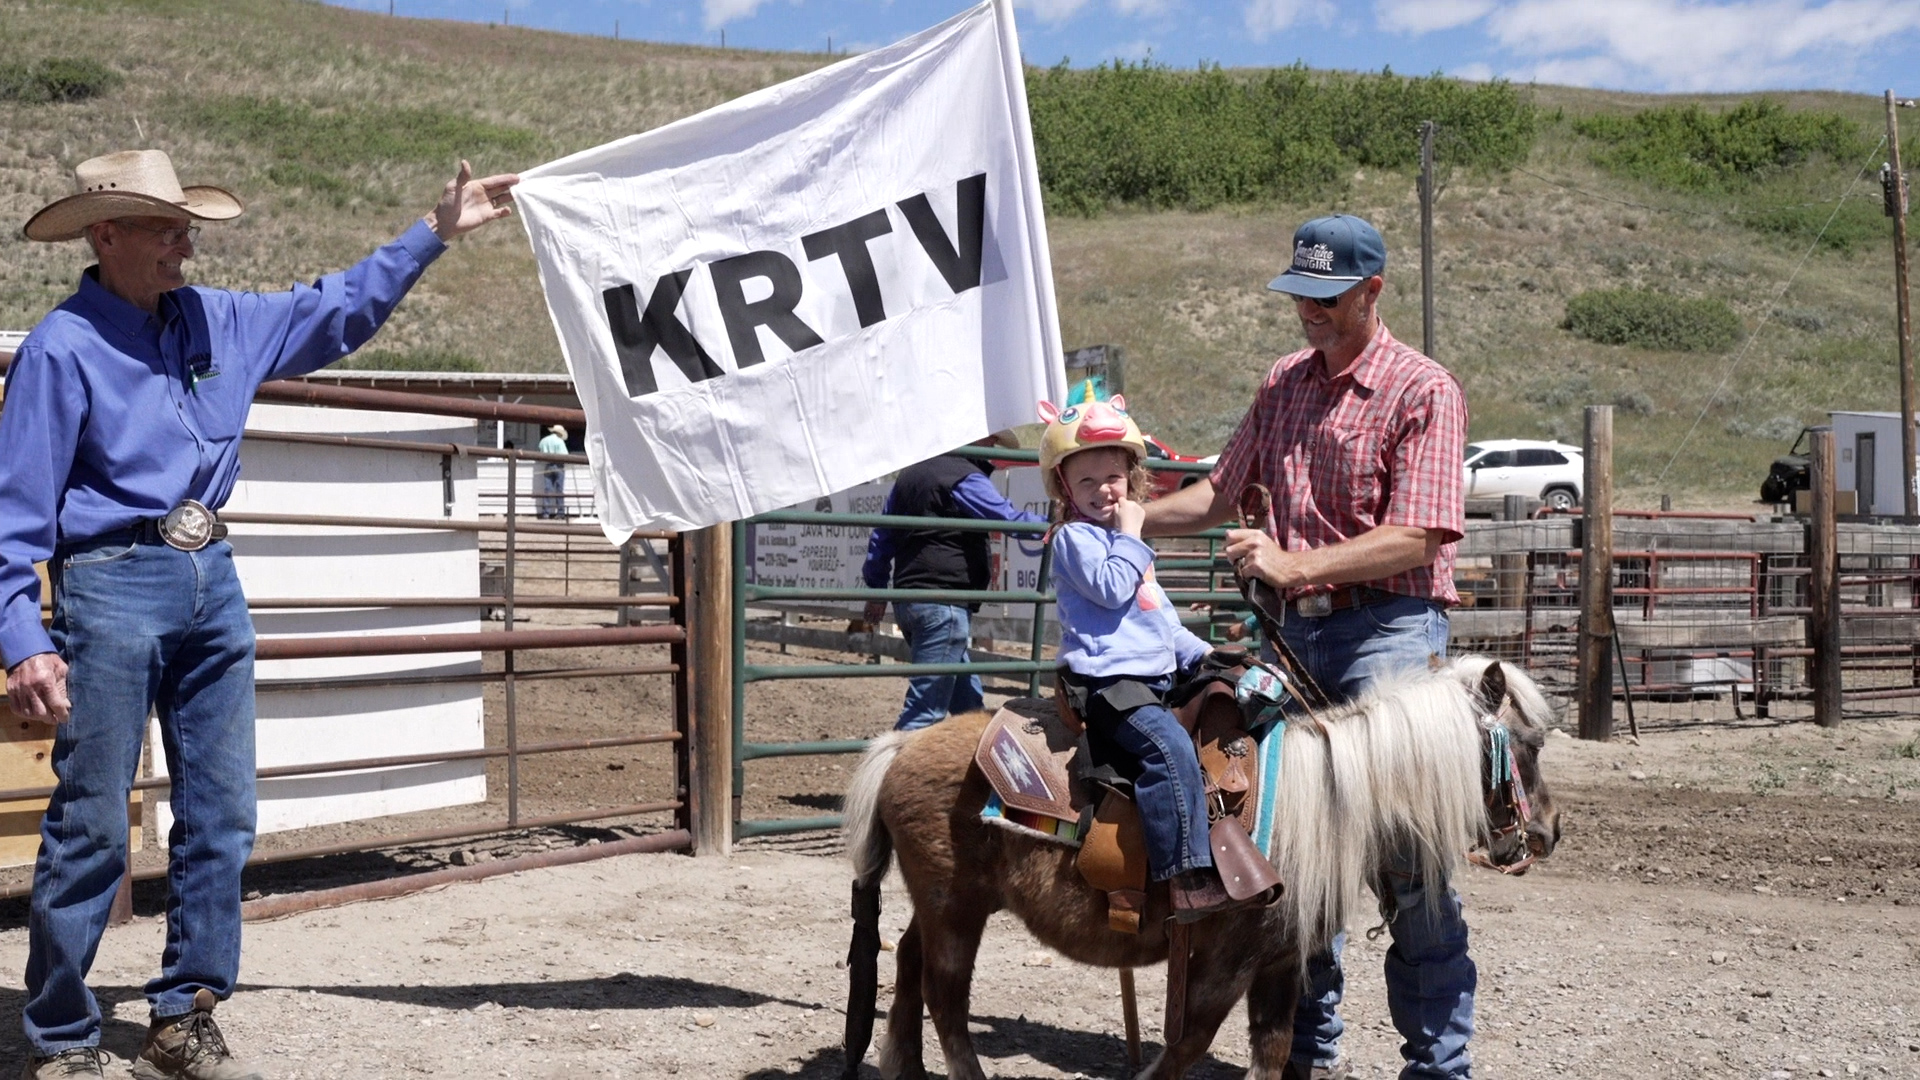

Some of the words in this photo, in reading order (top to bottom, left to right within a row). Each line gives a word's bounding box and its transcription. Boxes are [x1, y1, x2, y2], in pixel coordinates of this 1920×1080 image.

[1295, 257, 1332, 270] COWGIRL
[602, 172, 987, 398] KRTV
[800, 523, 823, 538] JAVA
[825, 523, 846, 538] HUT
[1017, 569, 1037, 588] BIG
